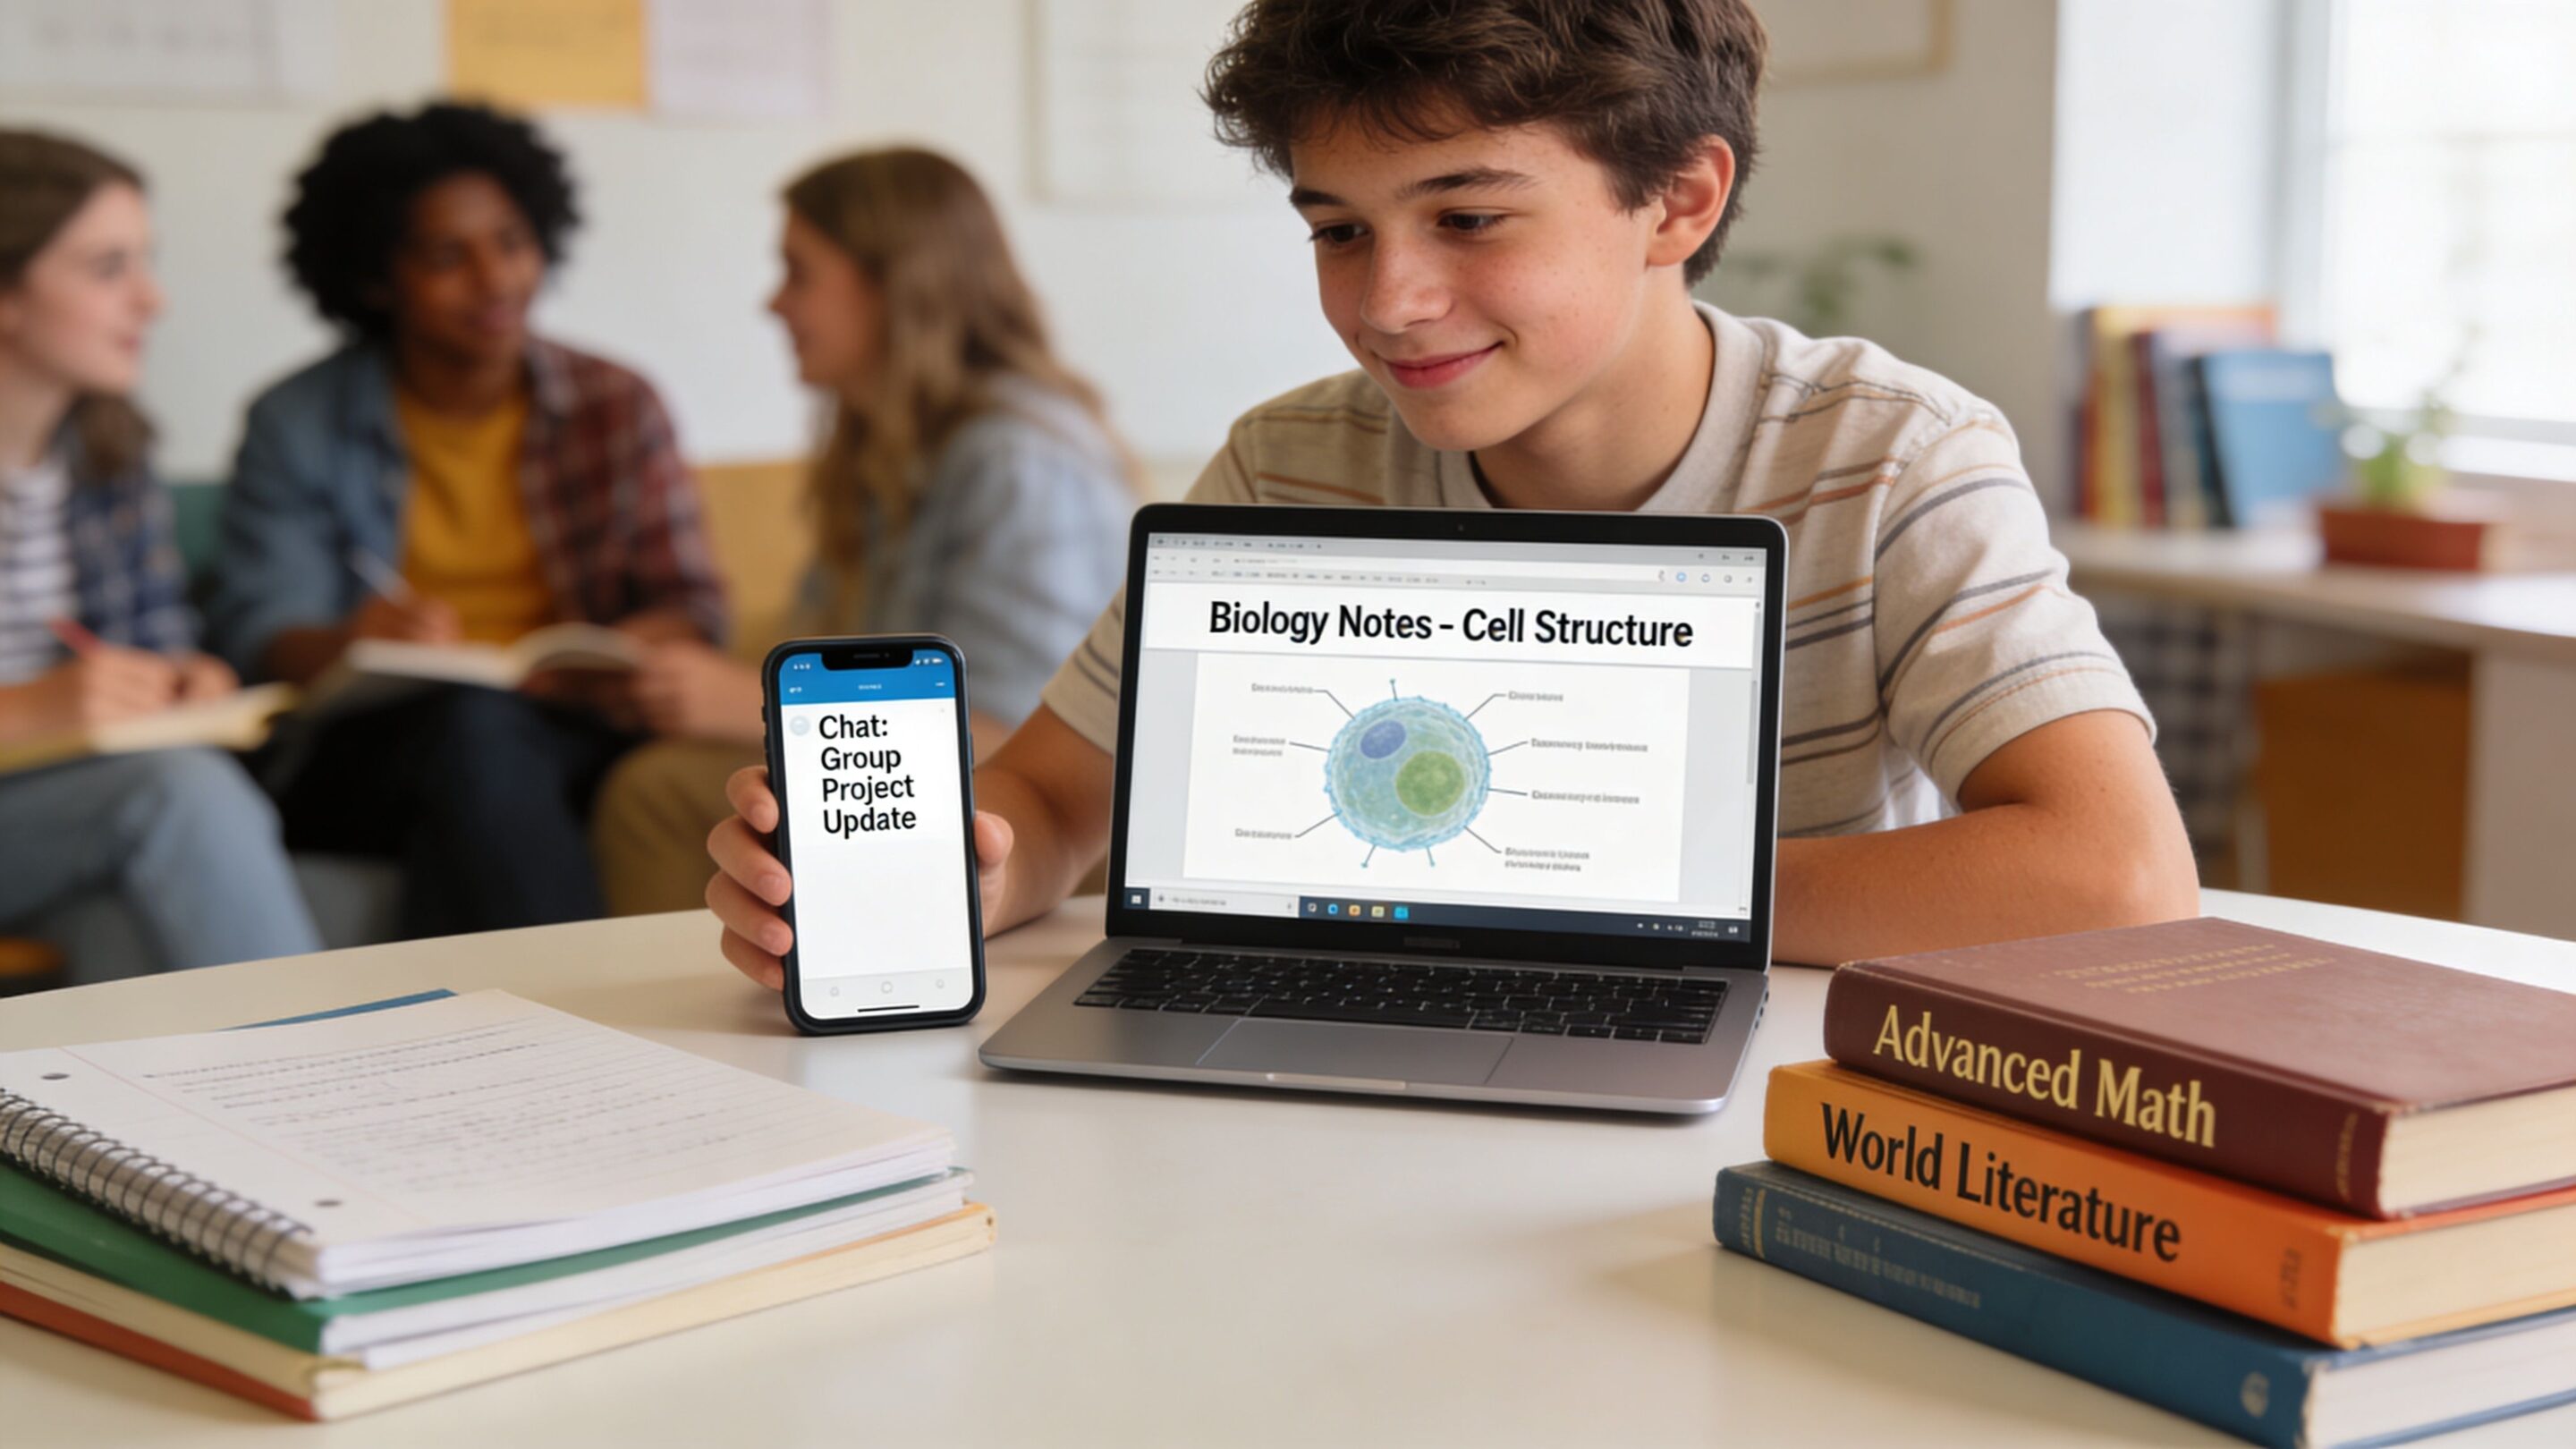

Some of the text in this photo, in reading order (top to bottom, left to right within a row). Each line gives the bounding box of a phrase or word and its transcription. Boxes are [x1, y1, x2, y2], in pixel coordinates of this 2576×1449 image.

[1209, 600, 1329, 646] Biology
[1338, 605, 1433, 640] Notes
[1462, 608, 1525, 643] Cell
[1533, 609, 1693, 648] Structure
[818, 714, 888, 740] Chat:
[820, 746, 902, 775] Group
[822, 775, 915, 806] Project
[823, 806, 917, 840] Update
[1873, 1004, 2215, 1148] Advanced Math
[1821, 1102, 1944, 1191] World
[1956, 1141, 2182, 1262] Literature
